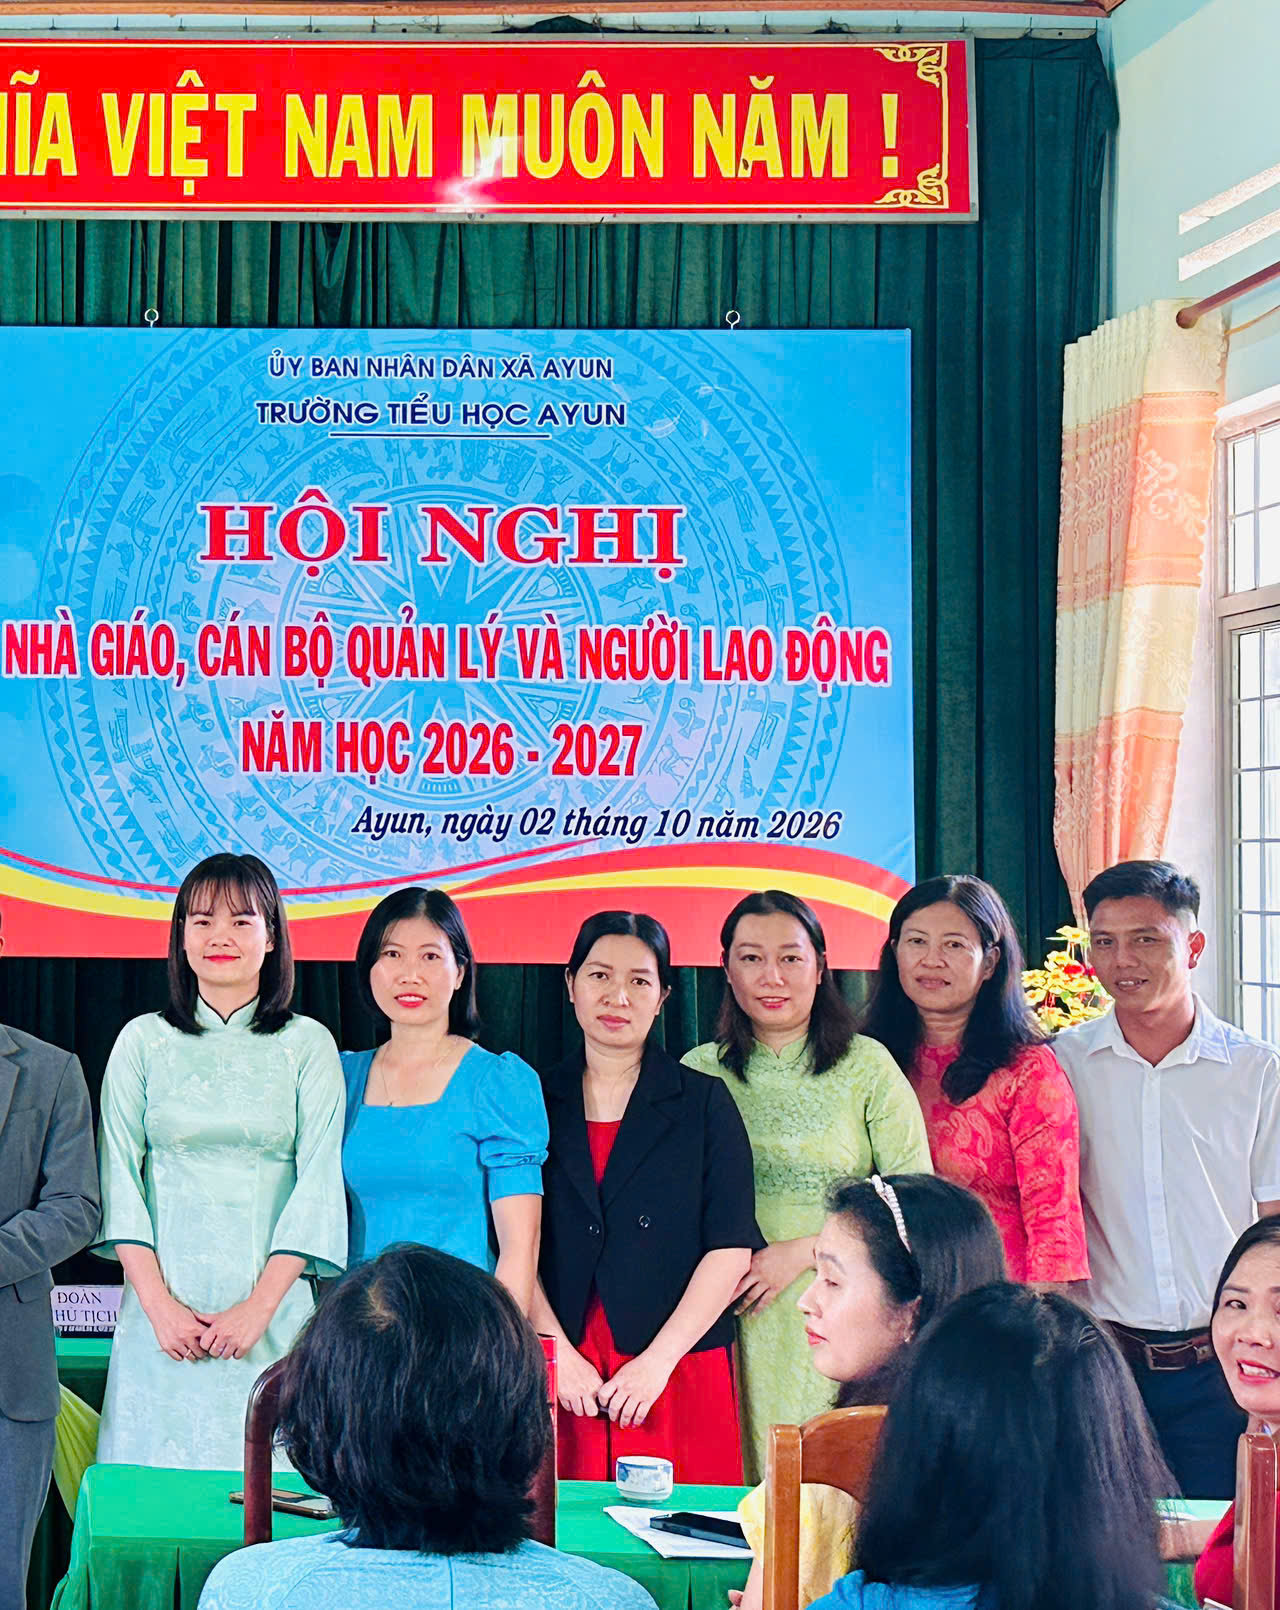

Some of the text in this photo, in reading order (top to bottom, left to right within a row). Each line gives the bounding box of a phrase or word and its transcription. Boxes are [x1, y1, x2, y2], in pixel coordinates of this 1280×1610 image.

[102, 70, 256, 195] VIỆT
[286, 94, 432, 177] NAM
[462, 70, 663, 179] MUÔN
[694, 76, 848, 177] NĂM
[882, 94, 898, 177] !
[271, 350, 611, 378] ỦY BAN NHÂN DÂN XÃ AYUN
[257, 393, 624, 430] TRƯỜNG TIỂU HỌC AYUN
[201, 488, 684, 580] HỘI NGHỊ
[5, 605, 889, 693] NHÀ GIÁO, CÁN BỘ QUẢN LÝ VÀ NGƯỜI LAO ĐỘNG
[242, 709, 322, 773] NĂM
[336, 721, 410, 785] HỌC
[424, 723, 514, 775] 2026
[552, 724, 642, 776] 2027
[352, 805, 842, 842] Ayun, ngày 02 tháng 10 năm 2026
[55, 1306, 77, 1322] HỦ
